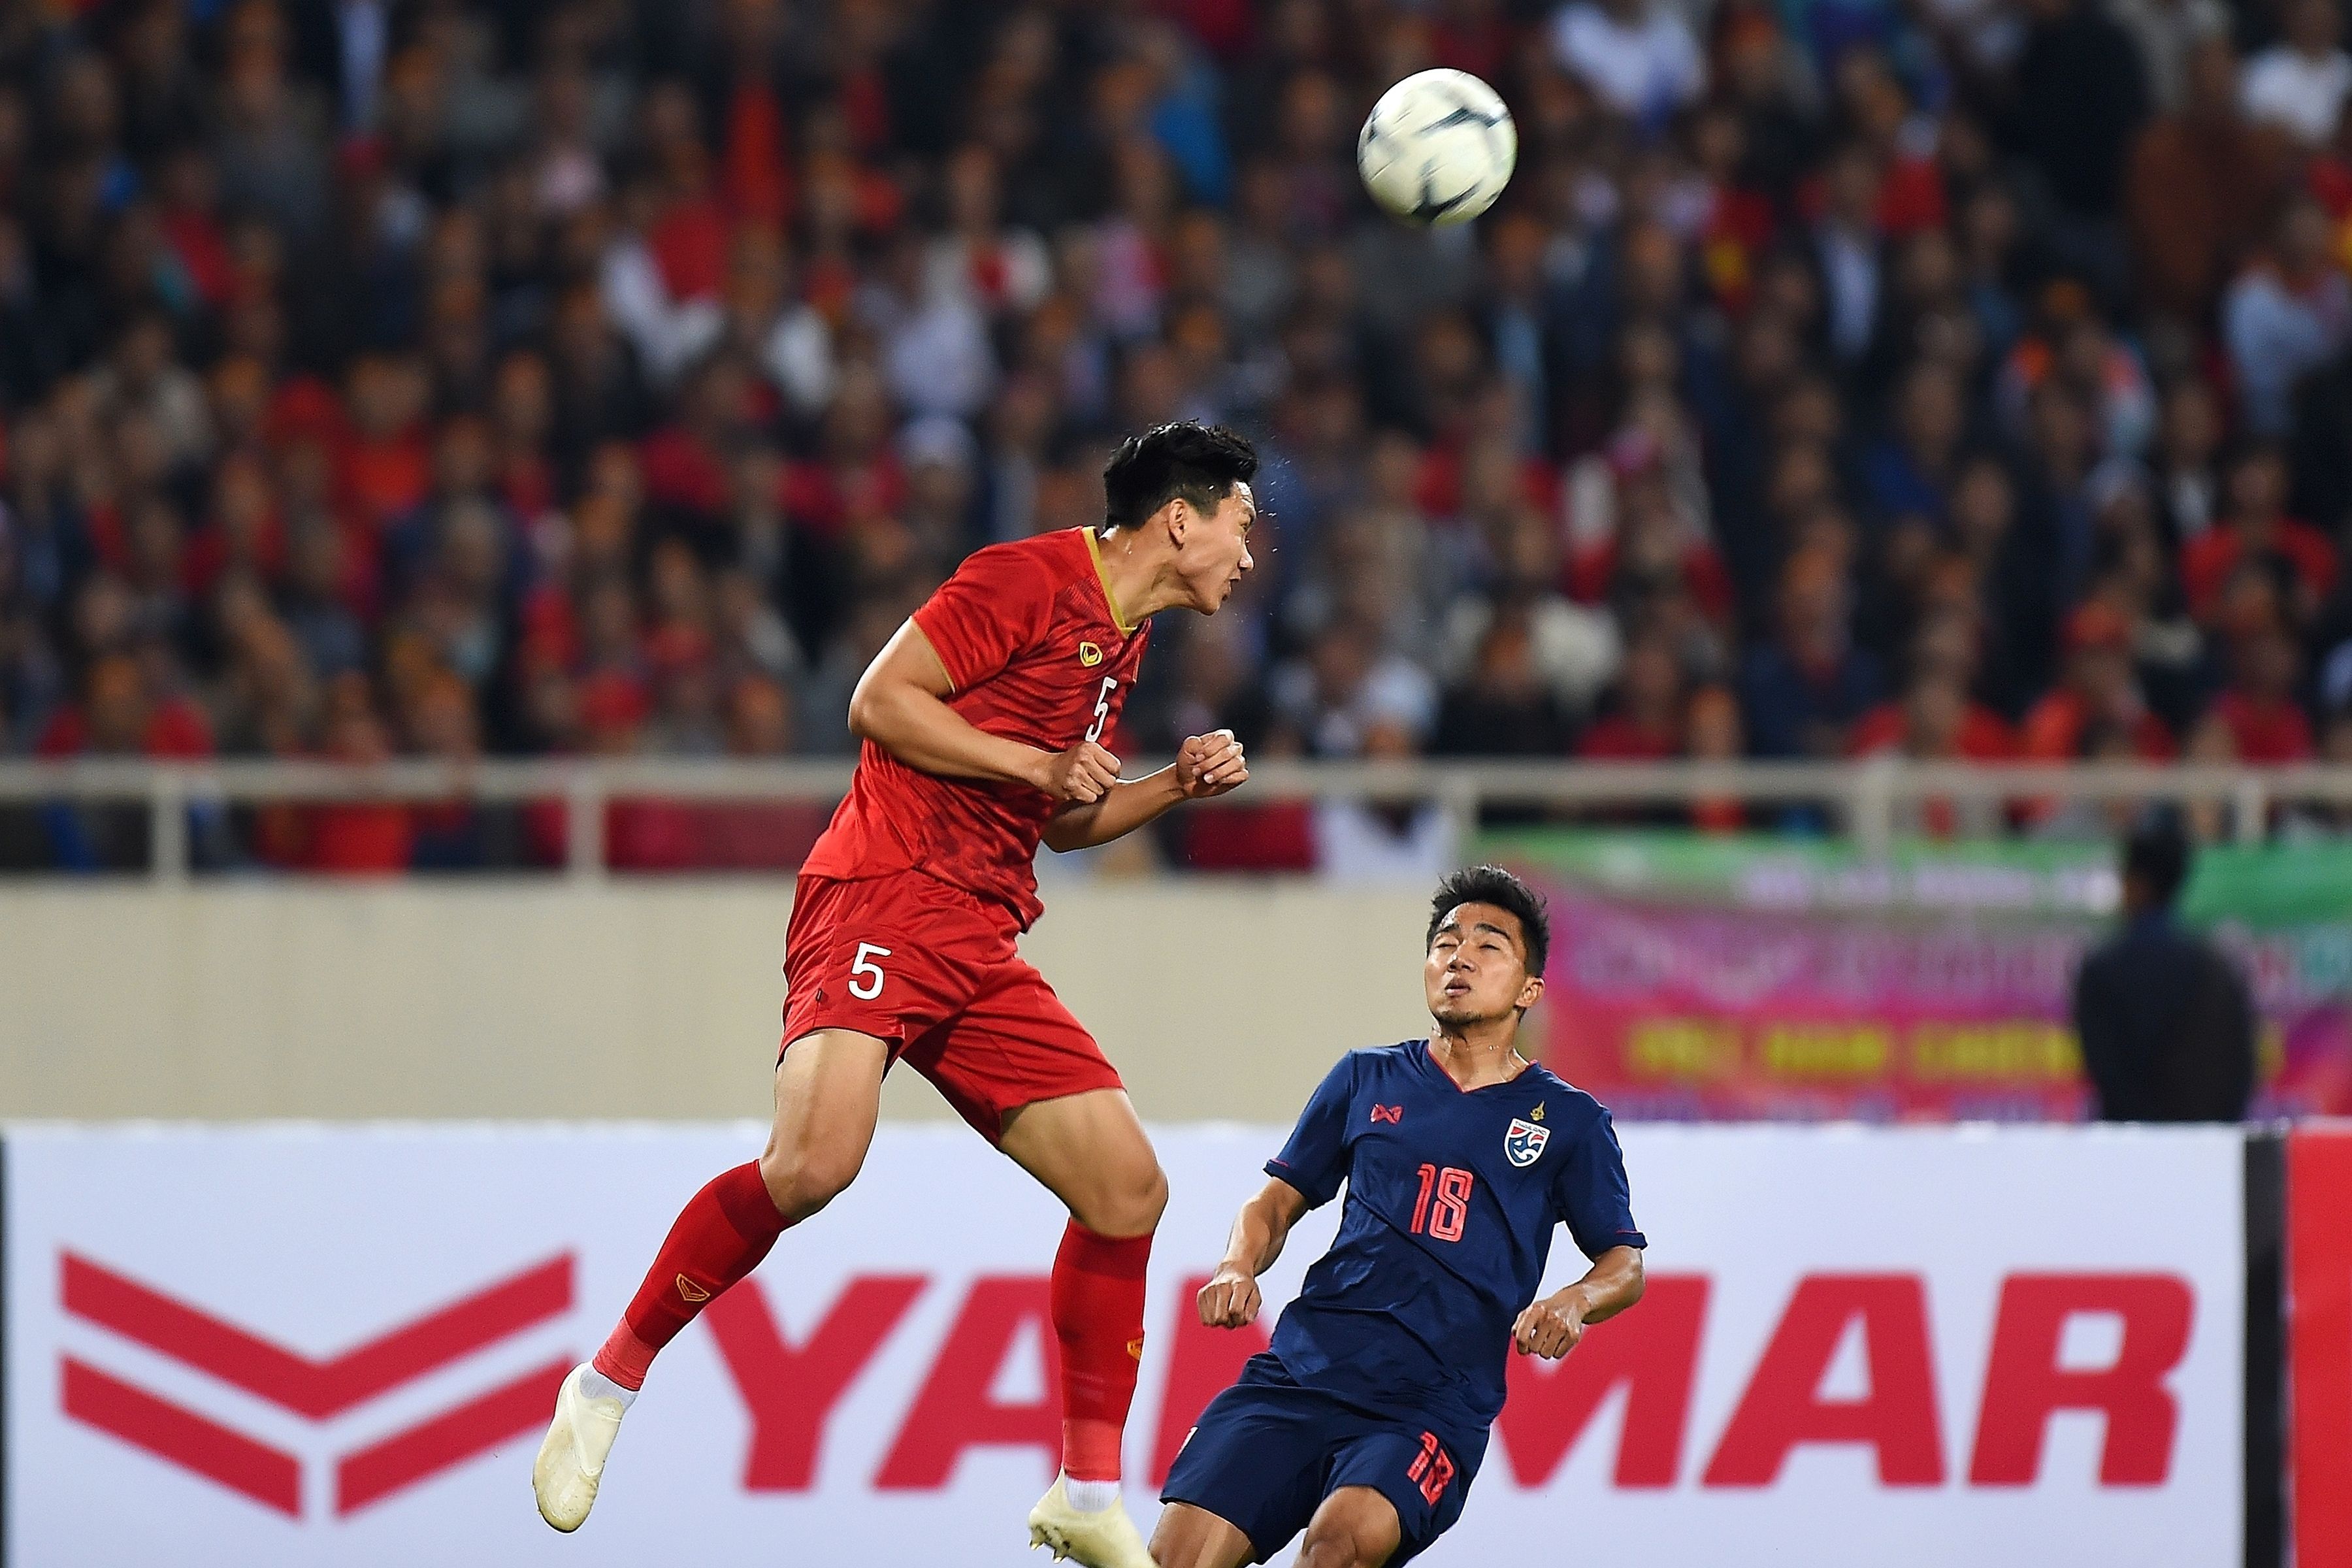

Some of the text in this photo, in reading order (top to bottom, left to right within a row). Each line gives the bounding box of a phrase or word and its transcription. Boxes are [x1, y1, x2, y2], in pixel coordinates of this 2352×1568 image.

[1085, 676, 1118, 742] 5
[848, 941, 892, 1000] 5
[1411, 1163, 1474, 1242] 18
